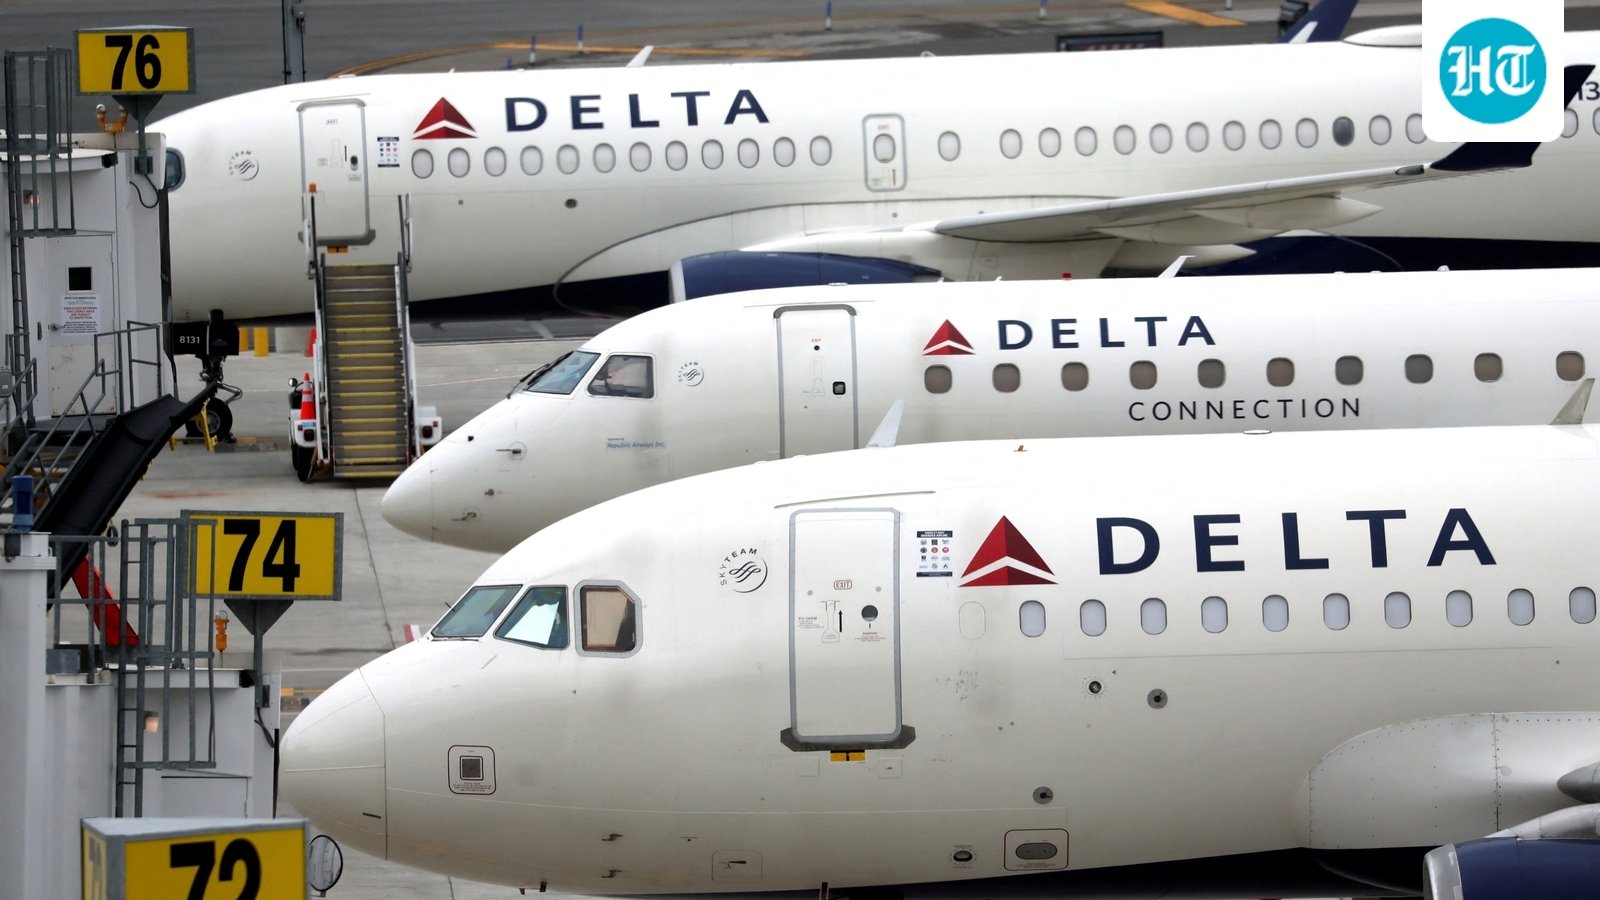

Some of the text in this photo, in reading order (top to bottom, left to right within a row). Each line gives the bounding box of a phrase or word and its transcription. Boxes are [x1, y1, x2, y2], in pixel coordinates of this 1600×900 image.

[104, 34, 162, 90] 76
[506, 89, 769, 132] DELTA
[179, 335, 201, 344] 8131
[998, 315, 1216, 351] DELTA
[1128, 397, 1361, 422] CONNECTION
[223, 518, 301, 593] 74
[1096, 507, 1497, 576] DELTA
[719, 548, 757, 586] SKYTEAM
[169, 838, 262, 900] 72
